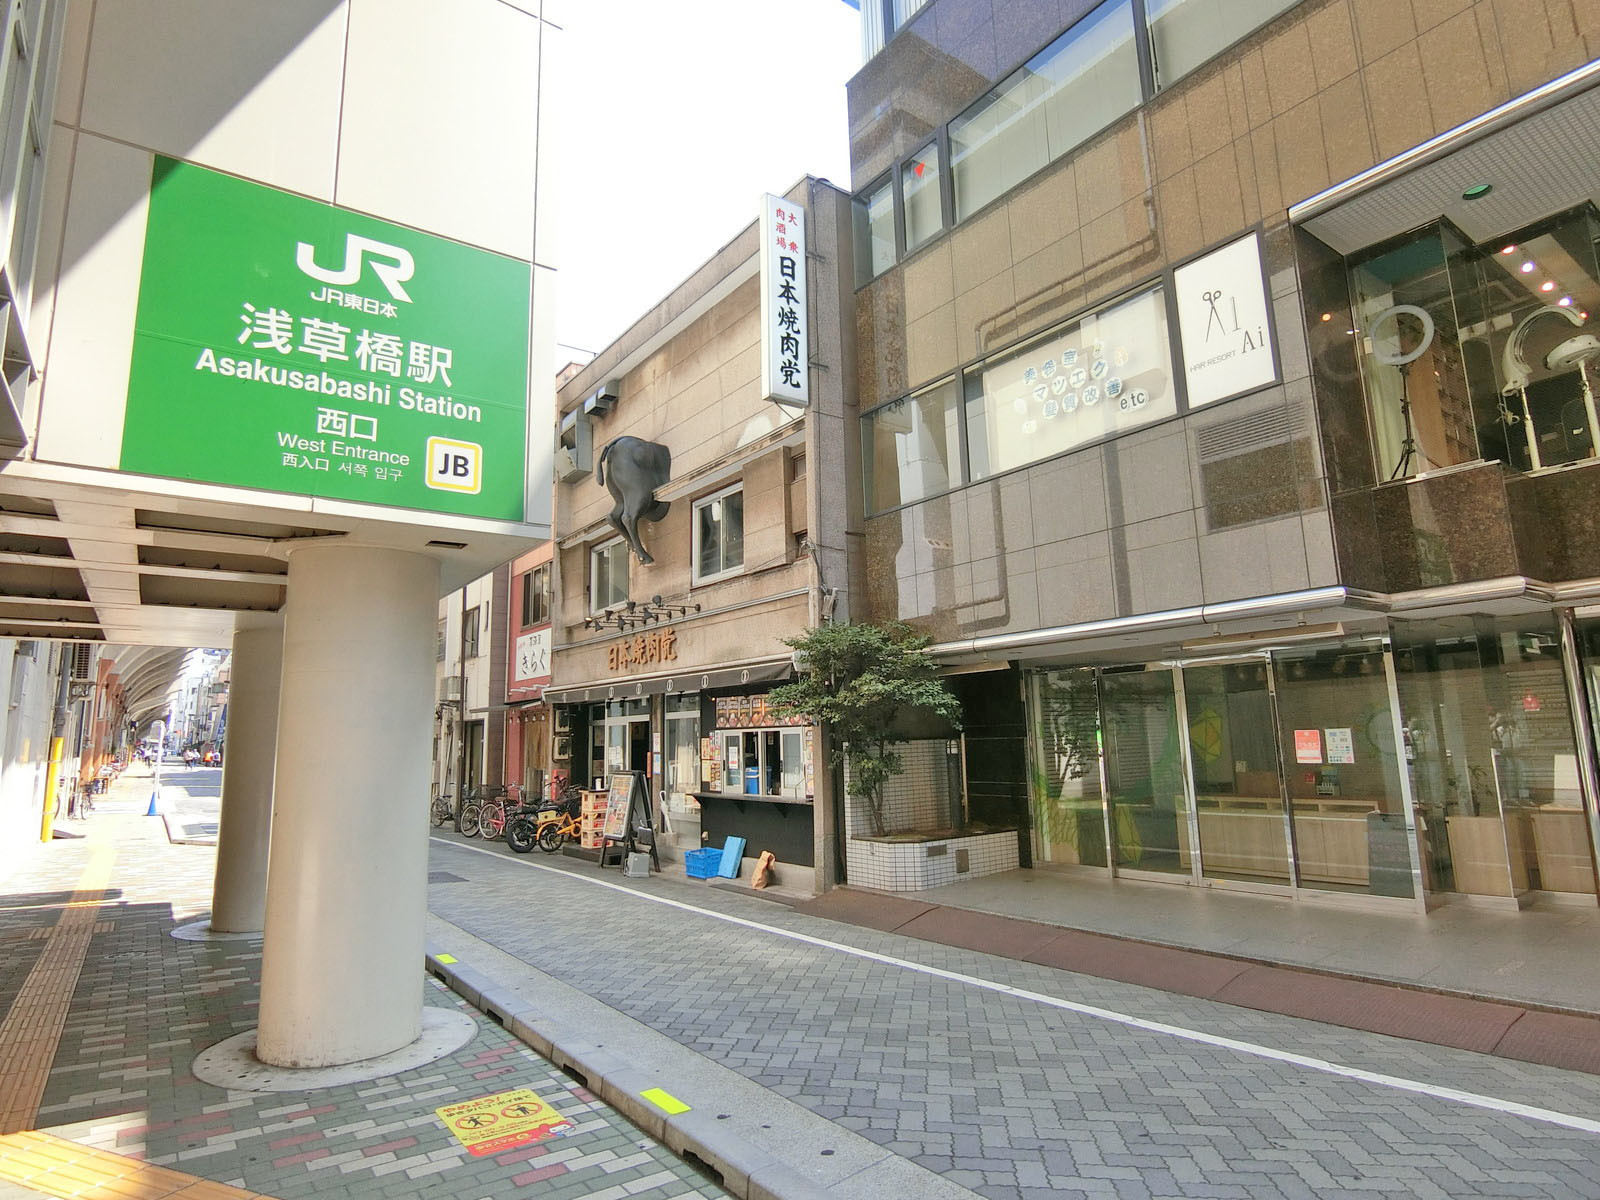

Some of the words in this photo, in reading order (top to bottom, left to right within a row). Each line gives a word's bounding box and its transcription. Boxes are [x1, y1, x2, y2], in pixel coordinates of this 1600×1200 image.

[775, 207, 787, 250] 肉酒場
[788, 213, 799, 254] 大衆
[296, 233, 415, 304] JR
[310, 286, 399, 319] JR東日本
[777, 255, 801, 389] 日本焼肉党
[1241, 325, 1265, 354] Ai
[237, 302, 453, 388] 浅草橋駅
[1189, 360, 1207, 373] HAIR
[1207, 350, 1237, 366] RESORT
[195, 348, 391, 407] Asakusabashi
[399, 388, 482, 422] Station
[1034, 360, 1107, 401] マツエク
[1119, 391, 1146, 410] etc
[316, 406, 378, 442] 西口
[277, 431, 327, 453] West
[331, 440, 411, 466] Entrance
[438, 452, 470, 477] JB
[282, 452, 330, 472] 西入口
[337, 462, 369, 478] 서쪽
[374, 467, 404, 482] 입구
